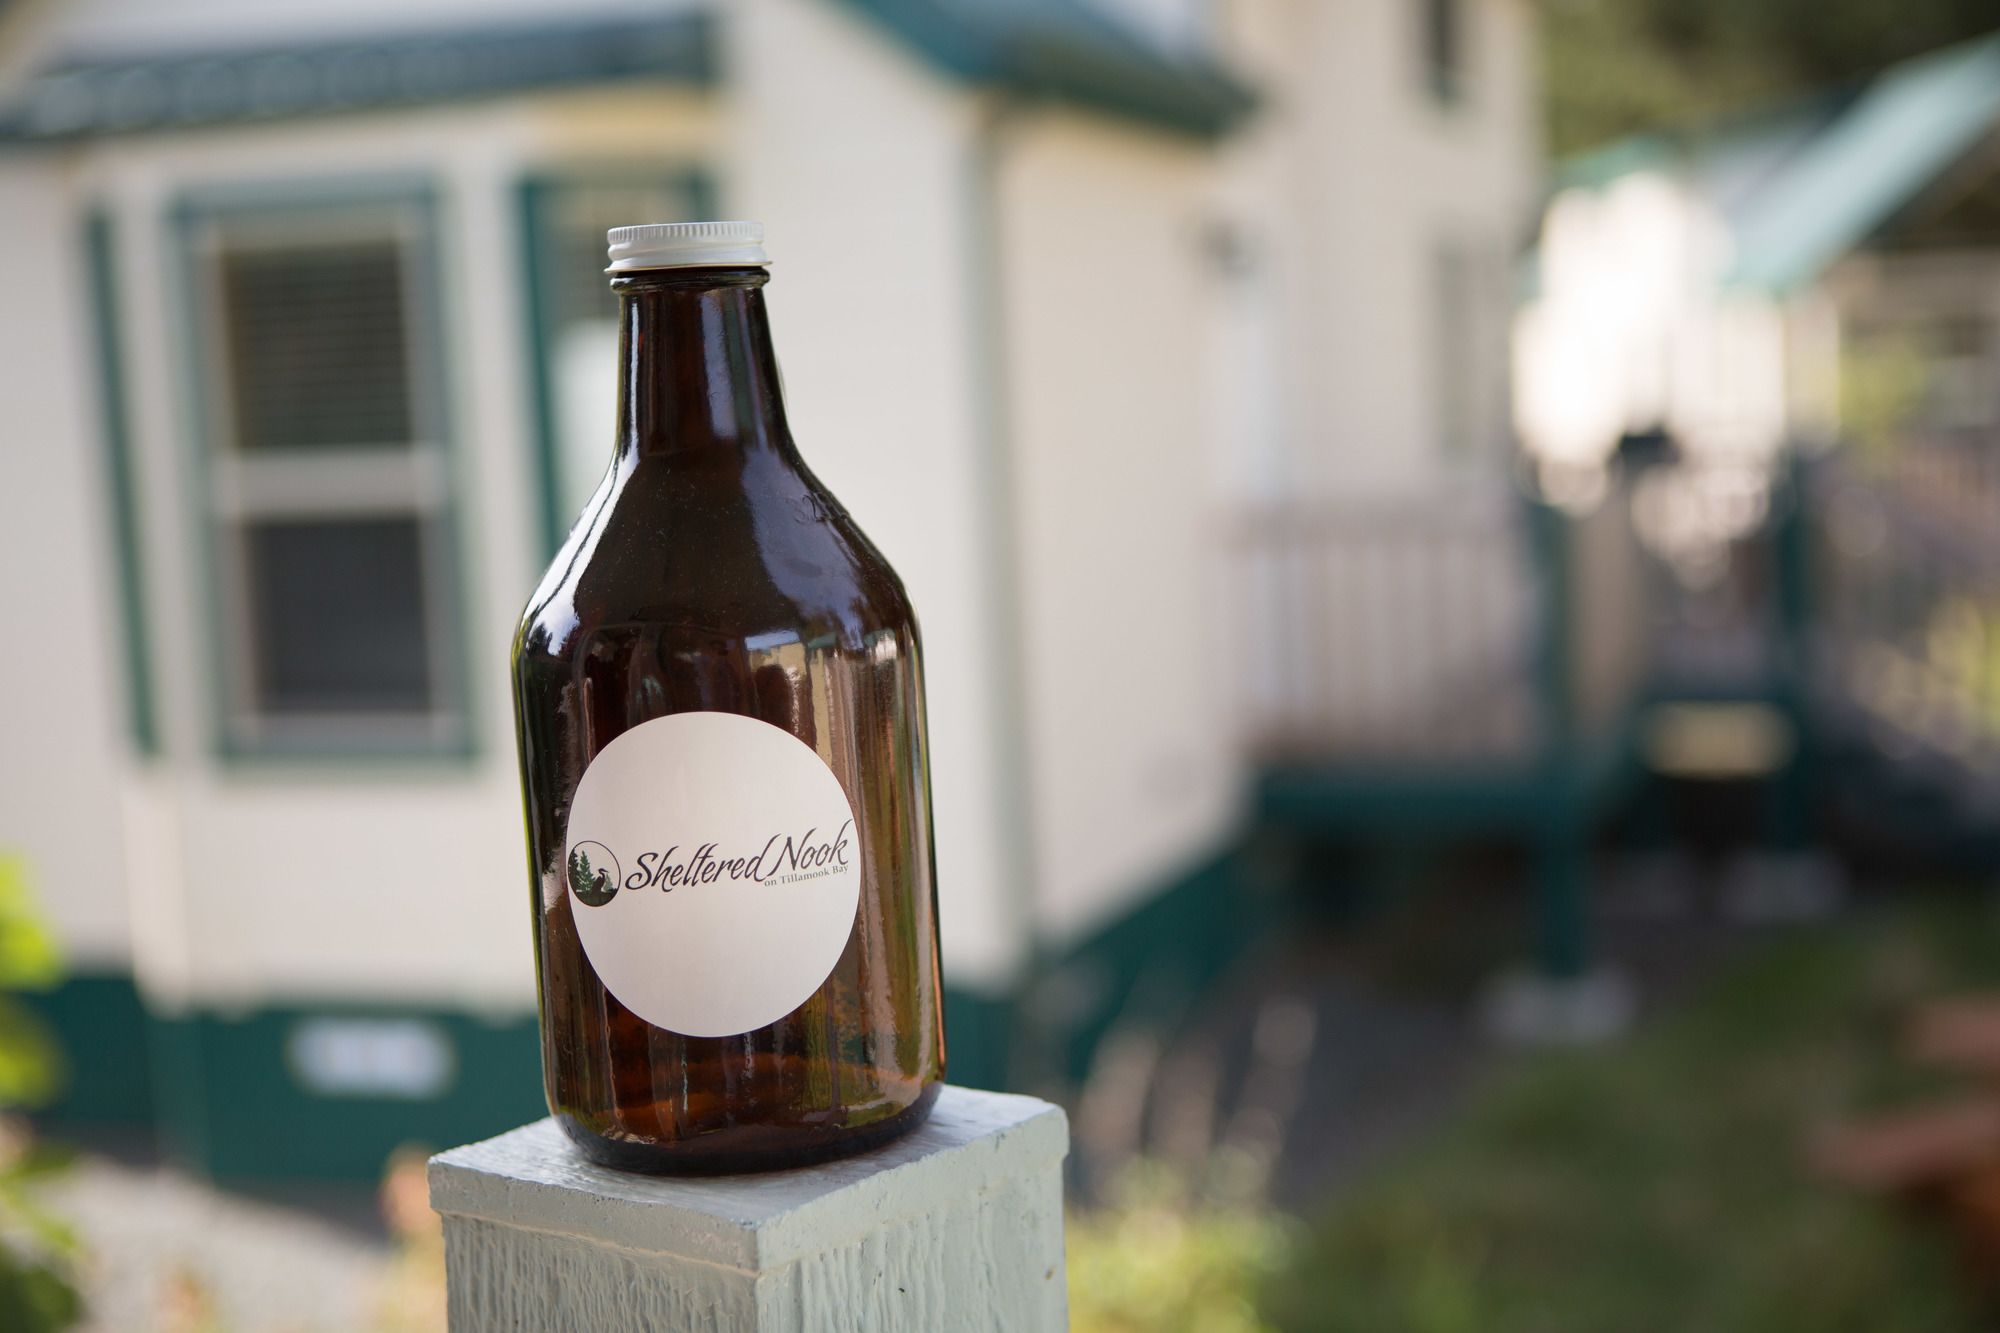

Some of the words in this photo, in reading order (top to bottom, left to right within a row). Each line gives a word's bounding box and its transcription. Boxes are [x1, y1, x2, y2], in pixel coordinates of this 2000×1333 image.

[625, 833, 781, 892] Sheltered
[766, 818, 853, 877] Nook
[764, 879, 778, 887] on
[779, 867, 831, 884] Tillamook
[832, 864, 849, 876] Bay
